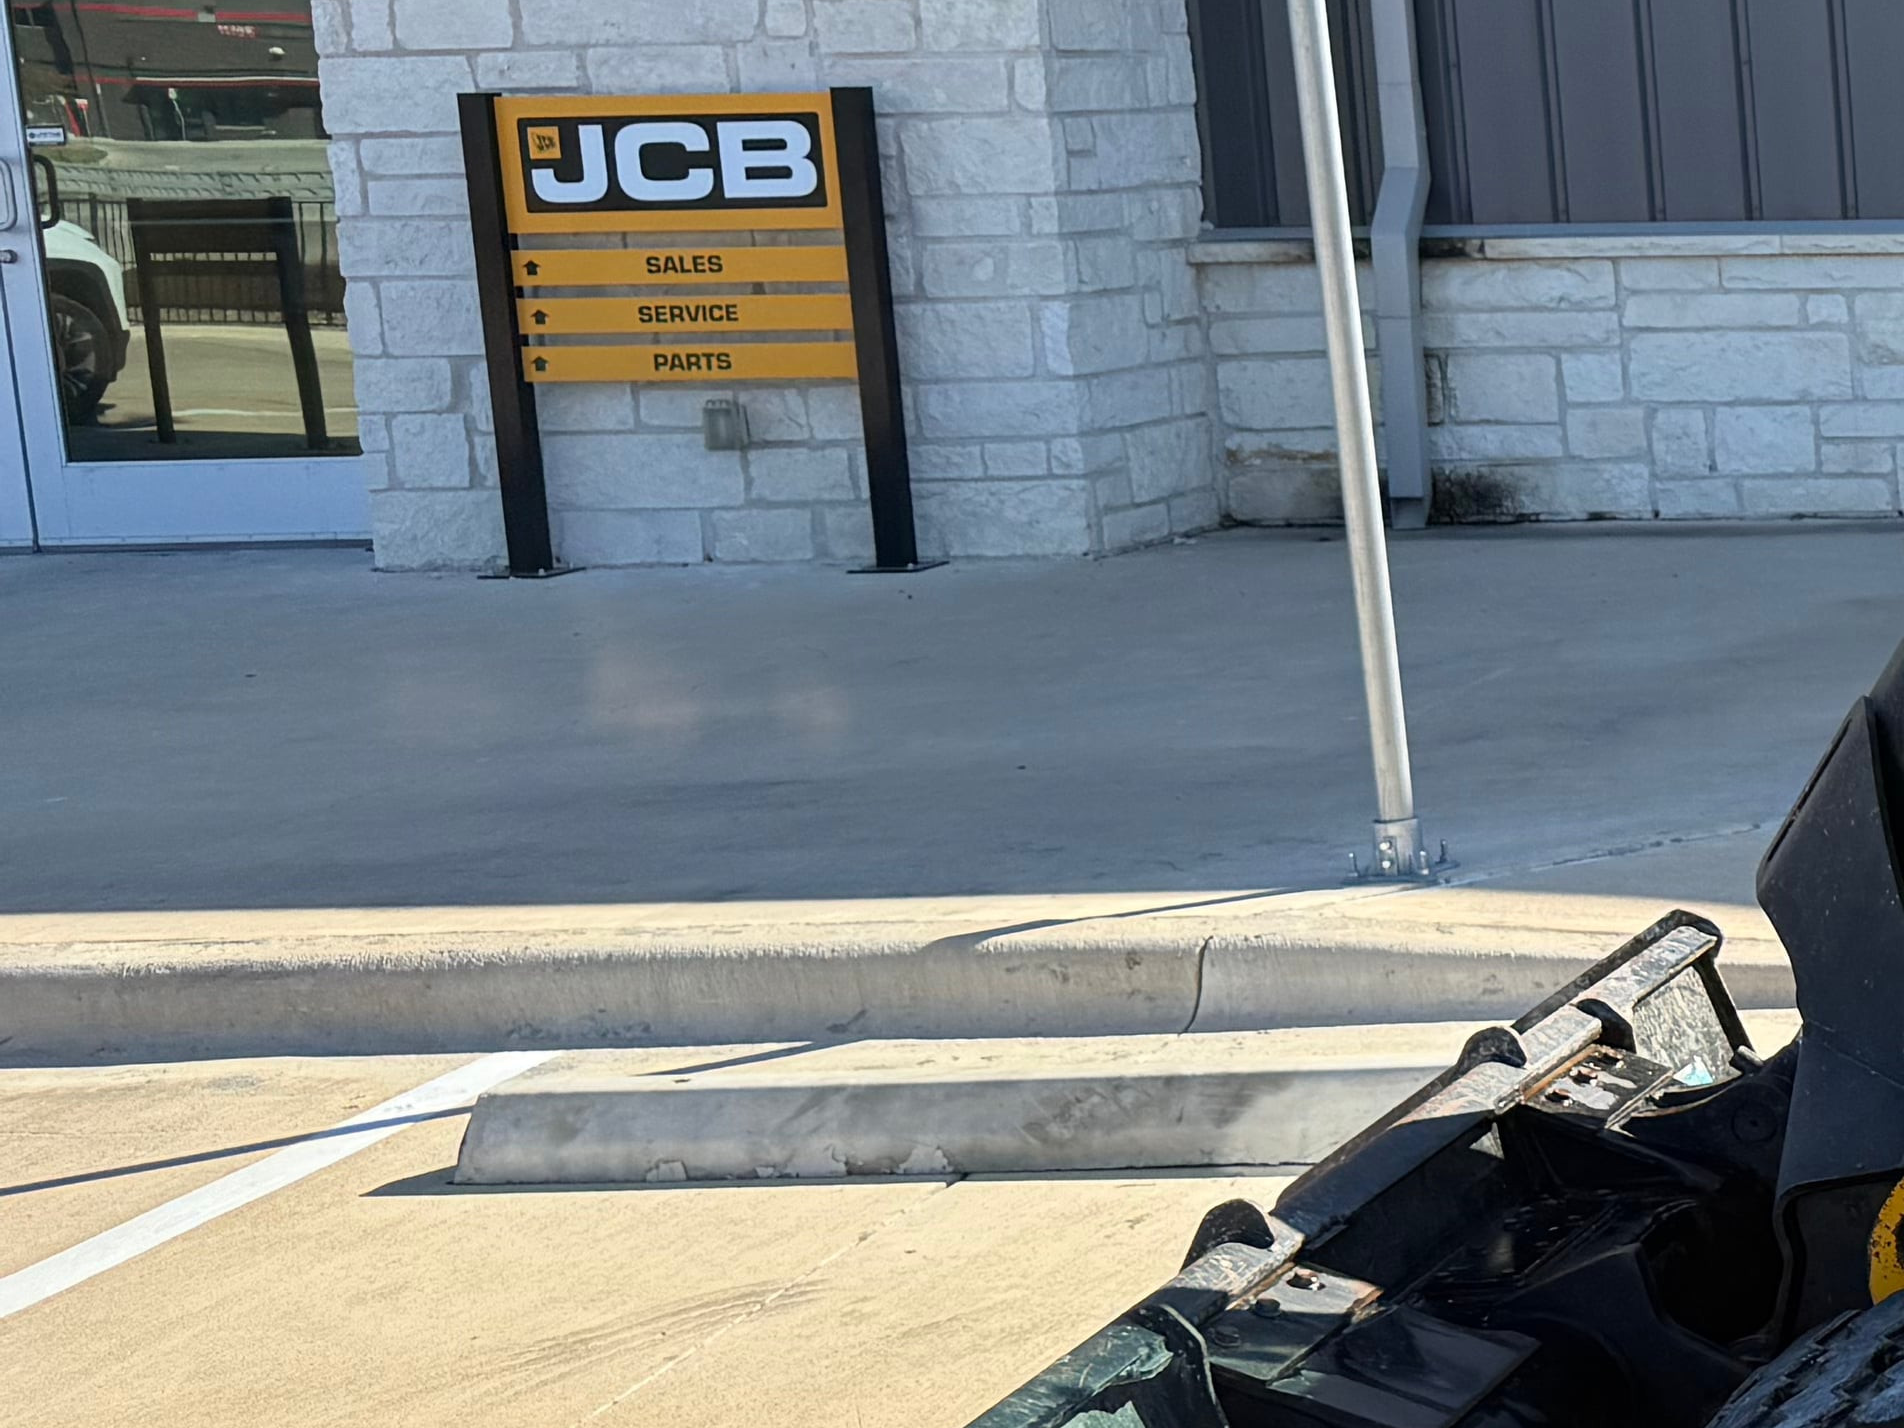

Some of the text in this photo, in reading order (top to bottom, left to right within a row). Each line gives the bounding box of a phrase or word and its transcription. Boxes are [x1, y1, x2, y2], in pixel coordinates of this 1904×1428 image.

[531, 120, 818, 203] JCB
[645, 255, 724, 274] SALES
[638, 304, 739, 324] SERVICE
[654, 352, 733, 371] PARTS
